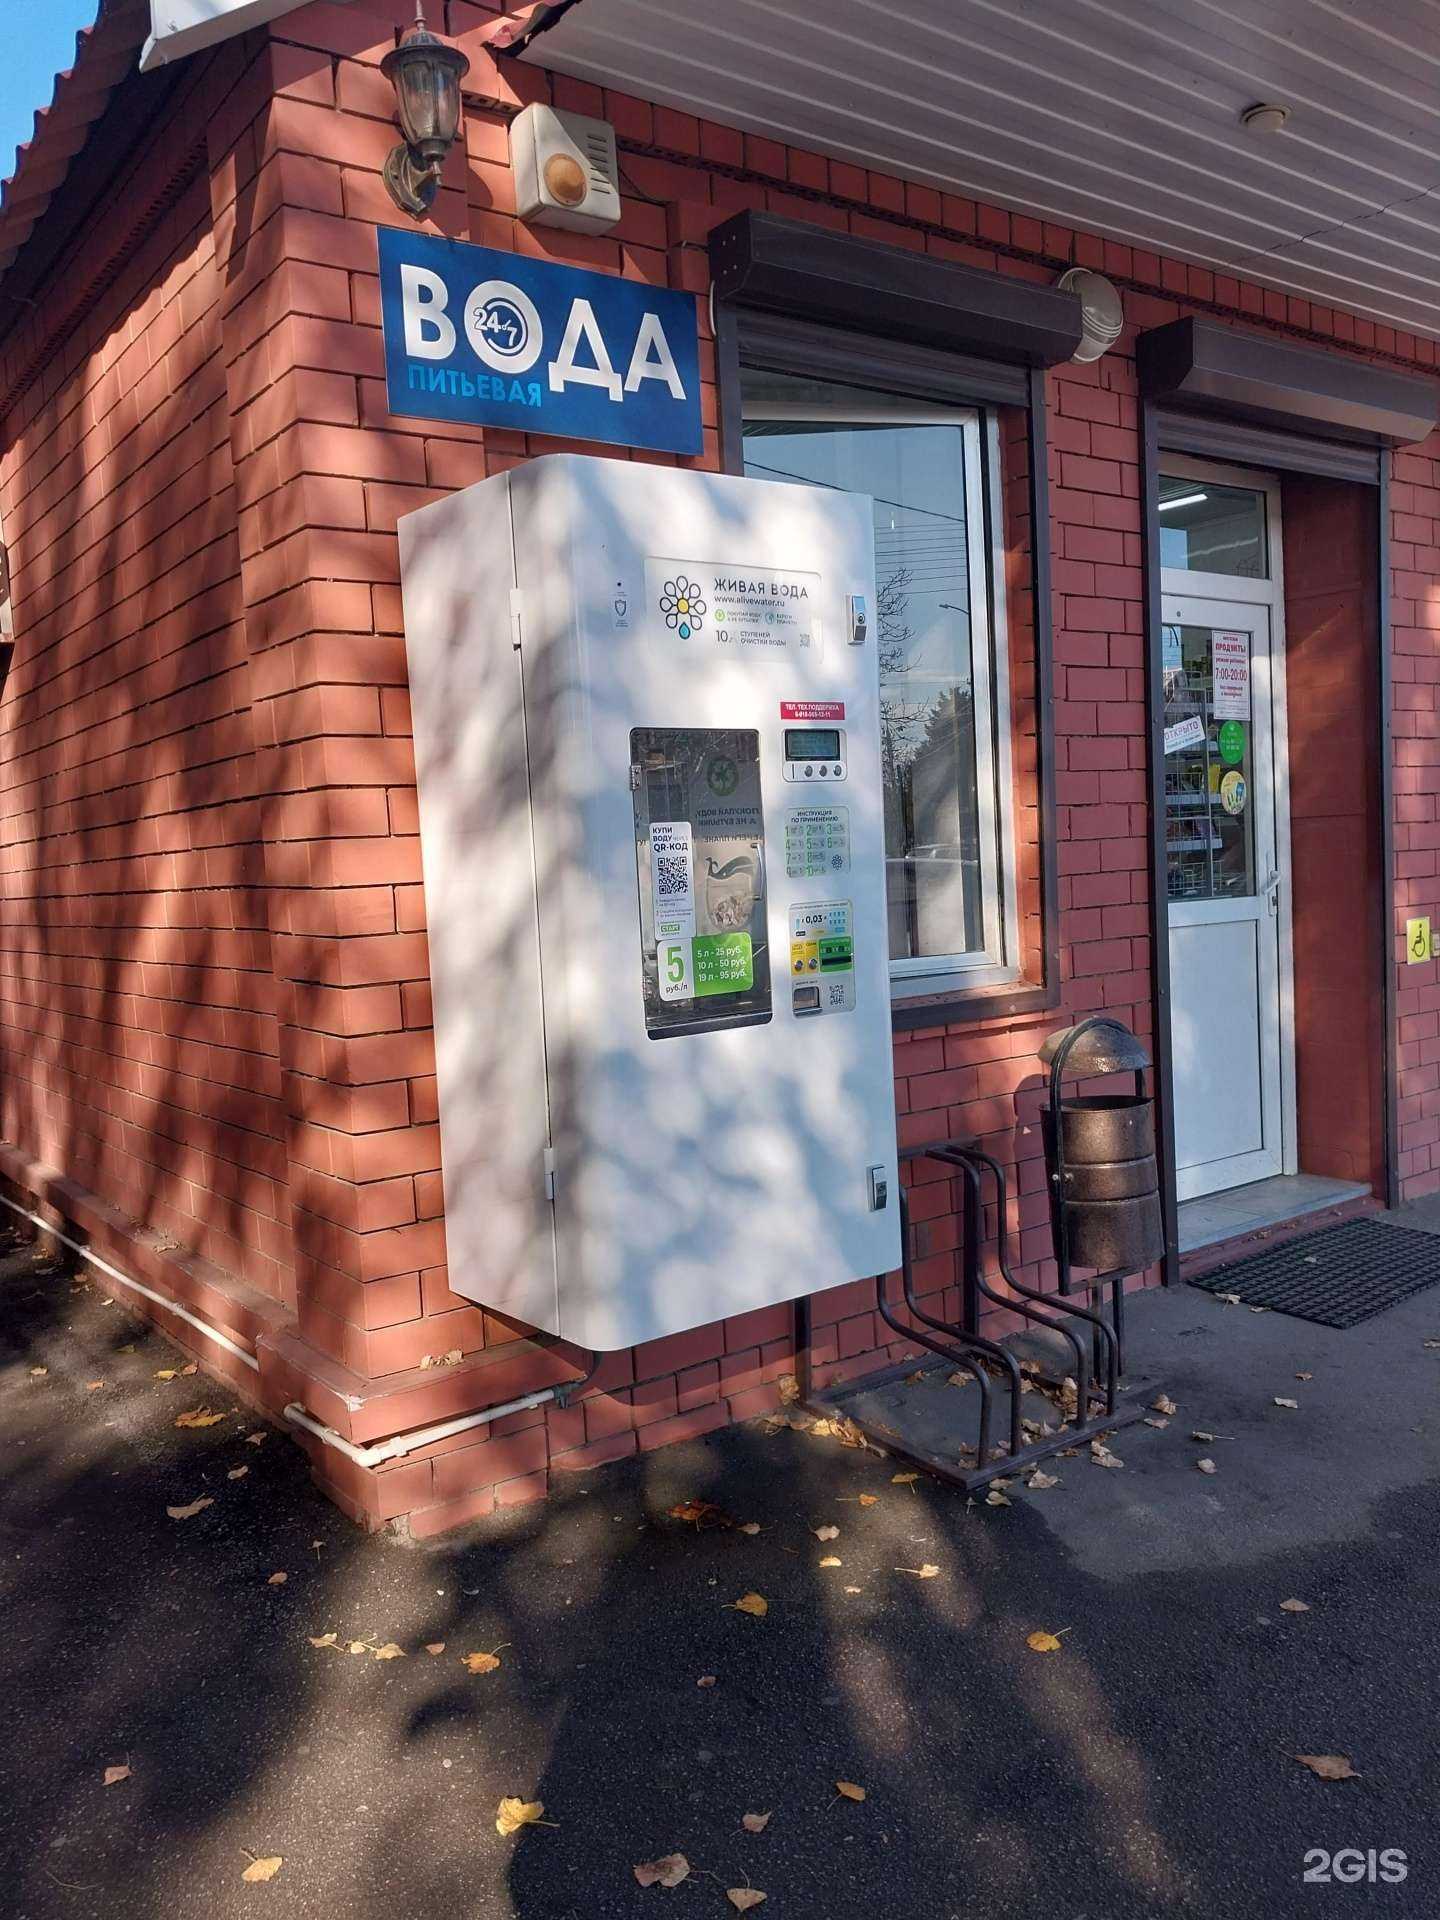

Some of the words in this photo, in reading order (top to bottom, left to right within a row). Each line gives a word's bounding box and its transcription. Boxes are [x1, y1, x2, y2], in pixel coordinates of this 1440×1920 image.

[400, 264, 686, 402] ВОДА
[408, 365, 542, 408] ПИТЬЕВАЯ
[714, 577, 765, 595] ЖИВАЯ
[771, 583, 809, 600] ВОДА
[714, 595, 785, 607] www.alivewater.ru
[716, 630, 729, 643] 10
[740, 638, 768, 646] ОЧИСТКИ
[768, 639, 786, 647] ВОДЫ
[1215, 643, 1247, 653] ПРОДУКТЫ
[1215, 667, 1248, 682] 7:00-20:00
[1164, 720, 1199, 741] ОТКРЫТО
[800, 815, 839, 823] ПРИМЕНЕНИЮ
[652, 826, 672, 834] КУПИ
[652, 834, 672, 842] ВОДУ
[653, 842, 688, 852] QR-КОД
[805, 914, 823, 925] 0,03
[716, 948, 724, 956] 25
[726, 945, 742, 957] руб.
[667, 946, 684, 983] 5
[720, 959, 729, 967] 50
[731, 957, 746, 967] руб.
[699, 973, 706, 982] 19
[731, 969, 746, 979] руб.
[665, 983, 688, 993] руб./л
